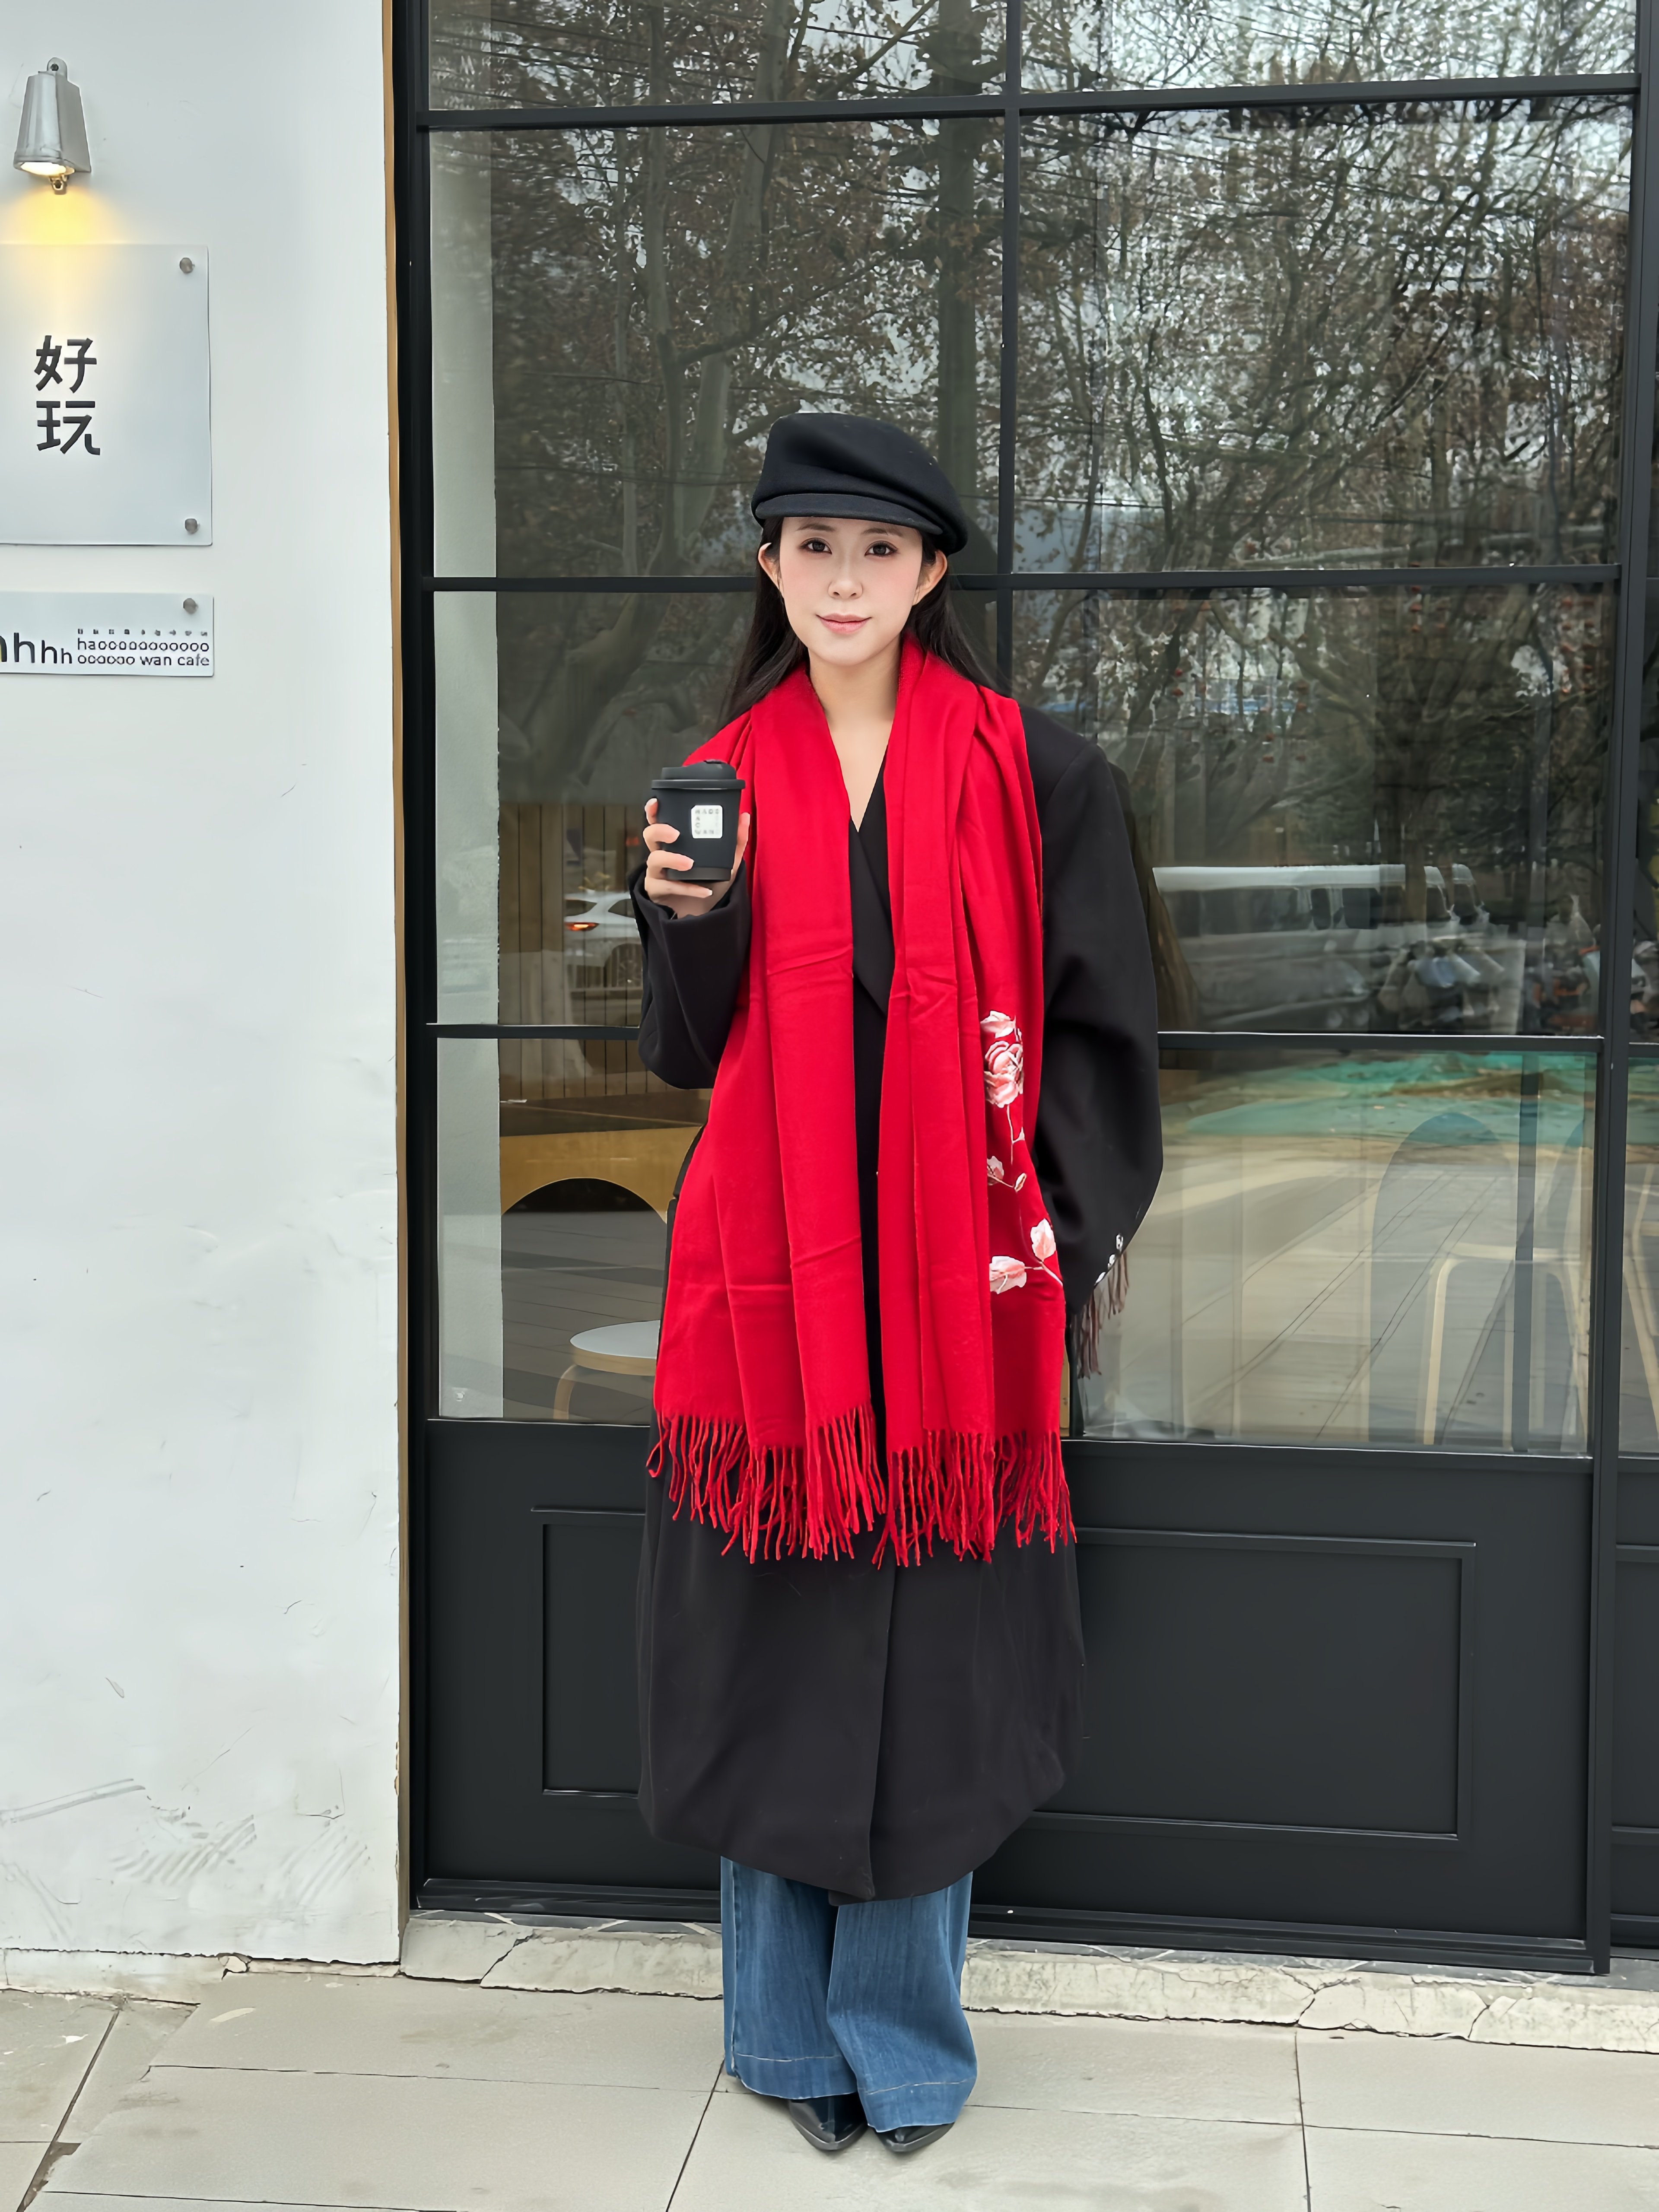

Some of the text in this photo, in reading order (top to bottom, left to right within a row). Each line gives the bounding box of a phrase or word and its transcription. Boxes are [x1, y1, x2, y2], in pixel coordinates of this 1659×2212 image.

[34, 335, 100, 455] 好玩
[140, 656, 172, 666] wan
[178, 654, 210, 666] cafe
